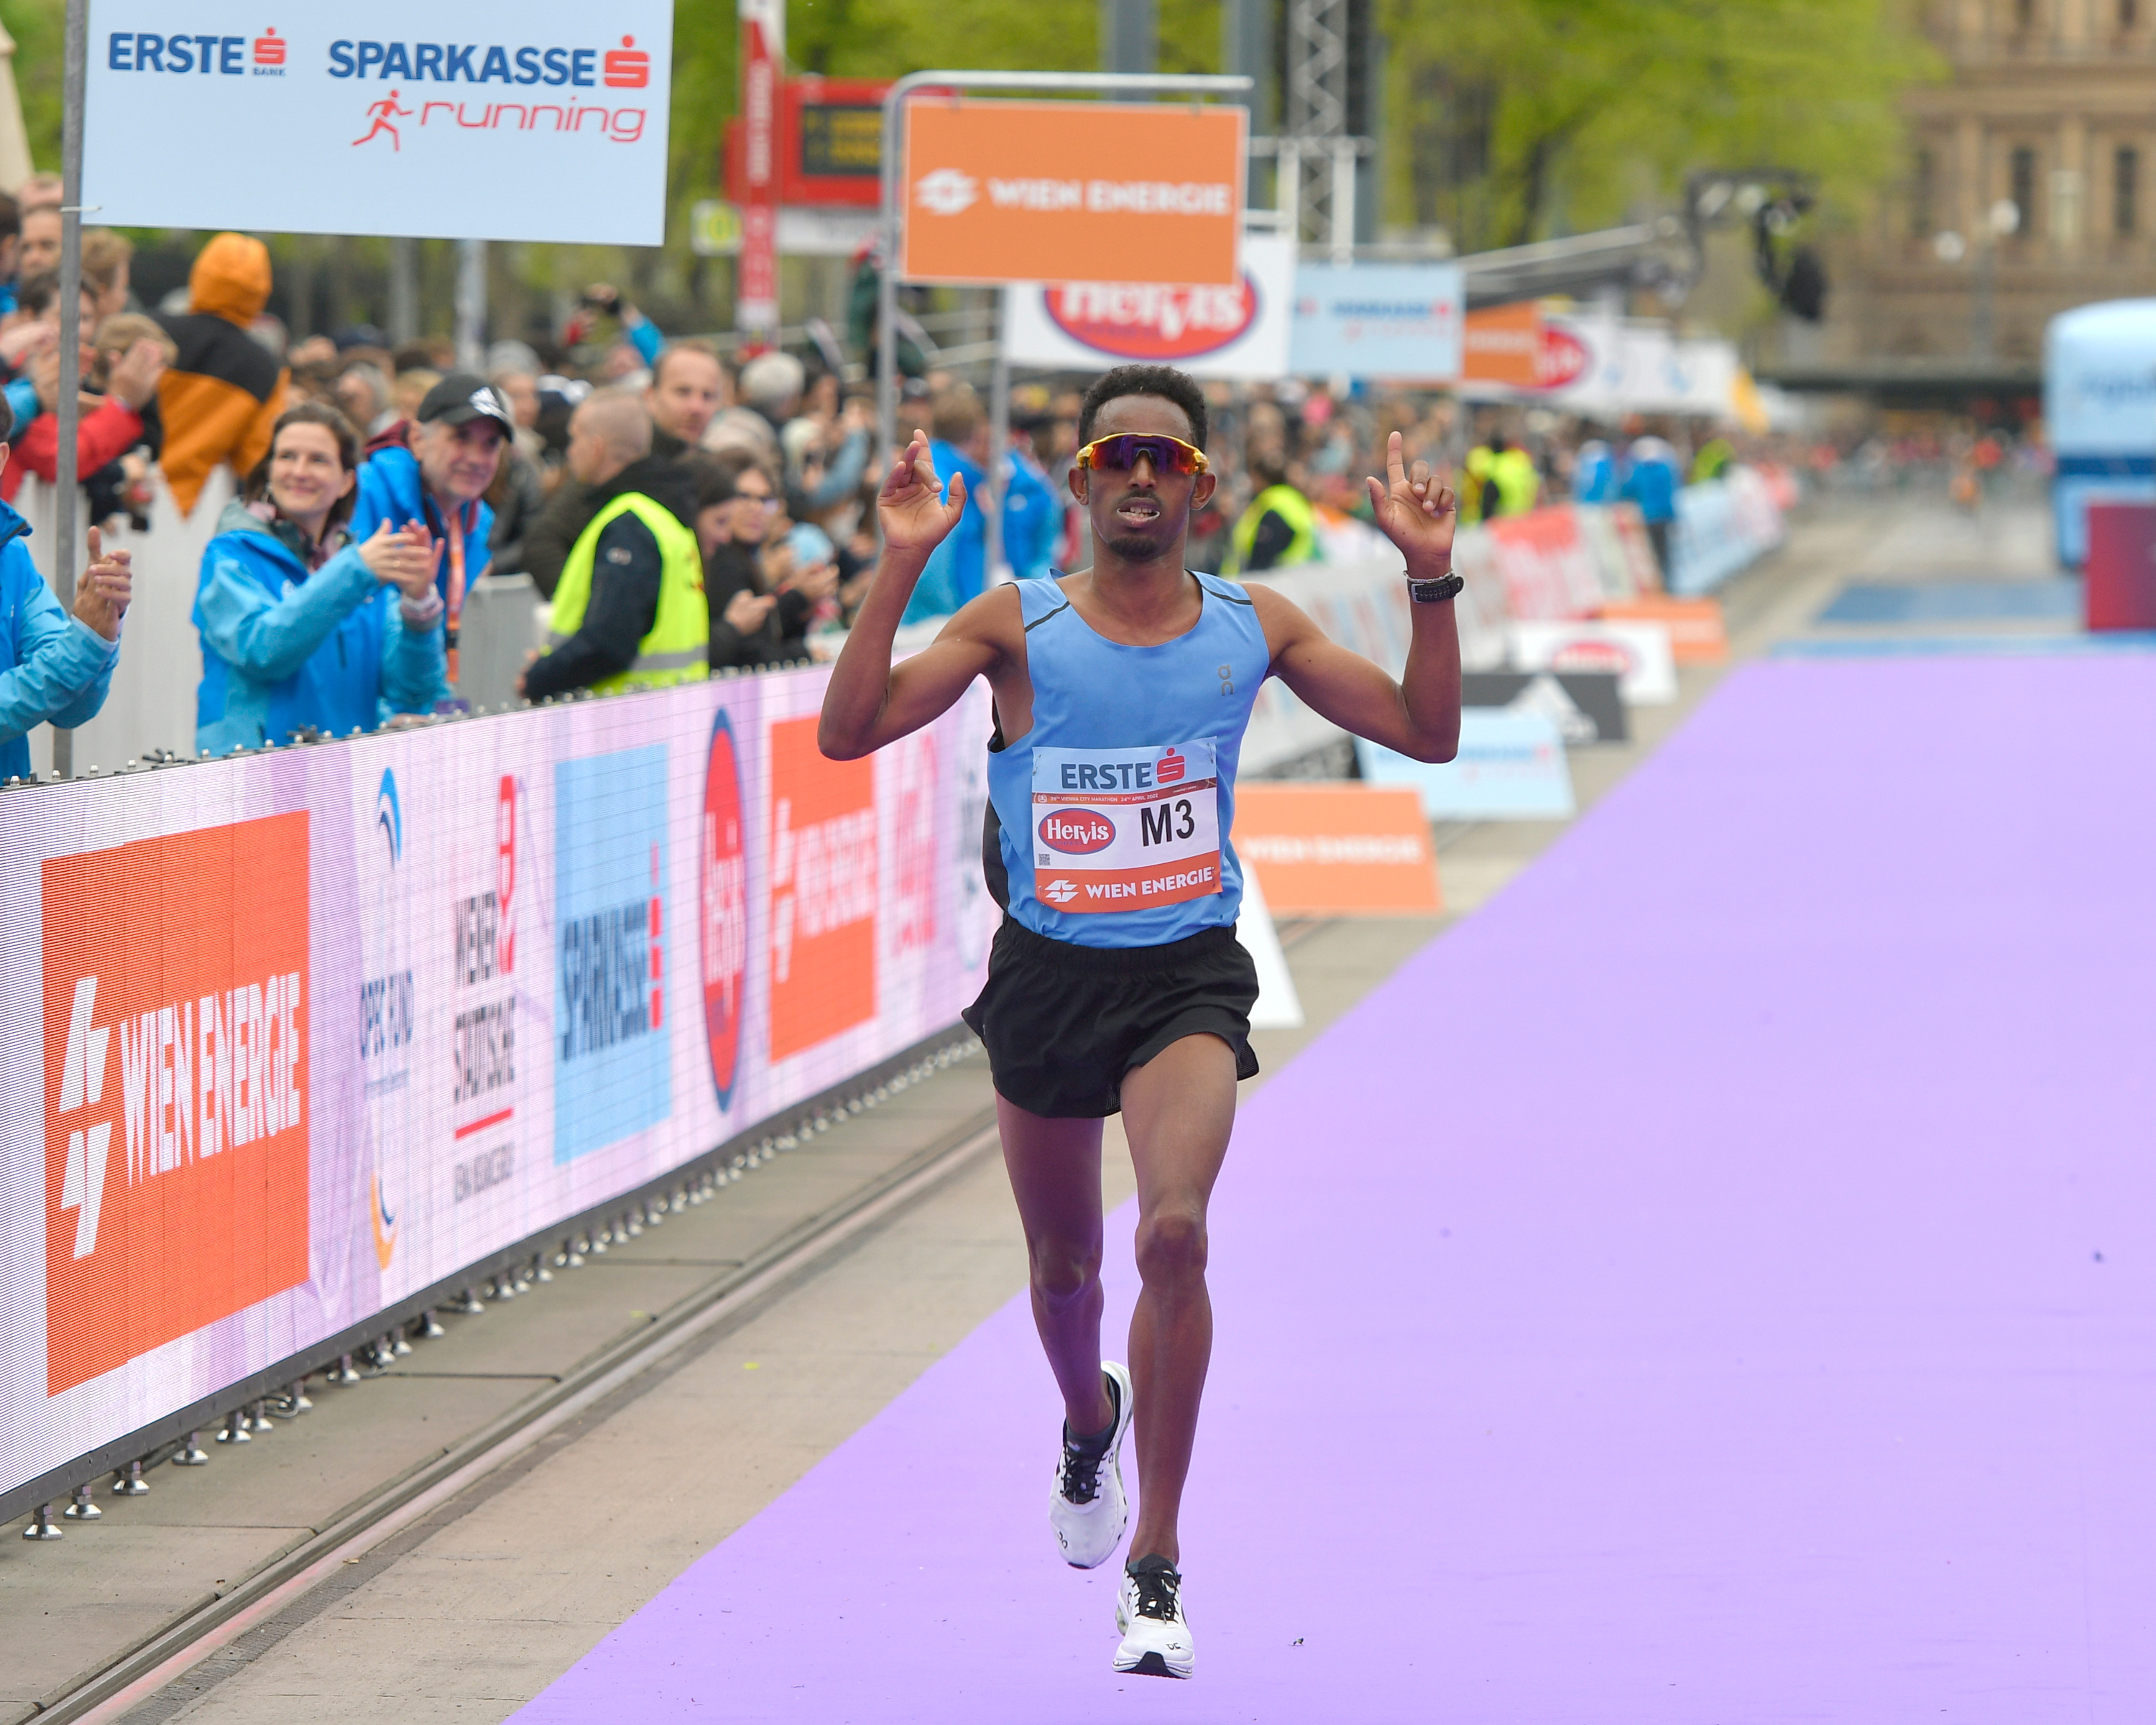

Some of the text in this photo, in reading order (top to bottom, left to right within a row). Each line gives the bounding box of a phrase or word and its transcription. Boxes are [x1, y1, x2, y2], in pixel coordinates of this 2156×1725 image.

[109, 32, 245, 75] ERSTE
[253, 67, 286, 77] BANK
[328, 40, 596, 87] SPARKASSE
[420, 96, 648, 142] running
[987, 178, 1232, 216] WIEN ENERGIE
[1061, 762, 1153, 790] ERSTE
[1047, 819, 1110, 845] Hervis
[1141, 799, 1196, 847] M3
[1084, 866, 1215, 899] WIEN ENERGIE
[120, 972, 301, 1190] WIEN ENERGIE
